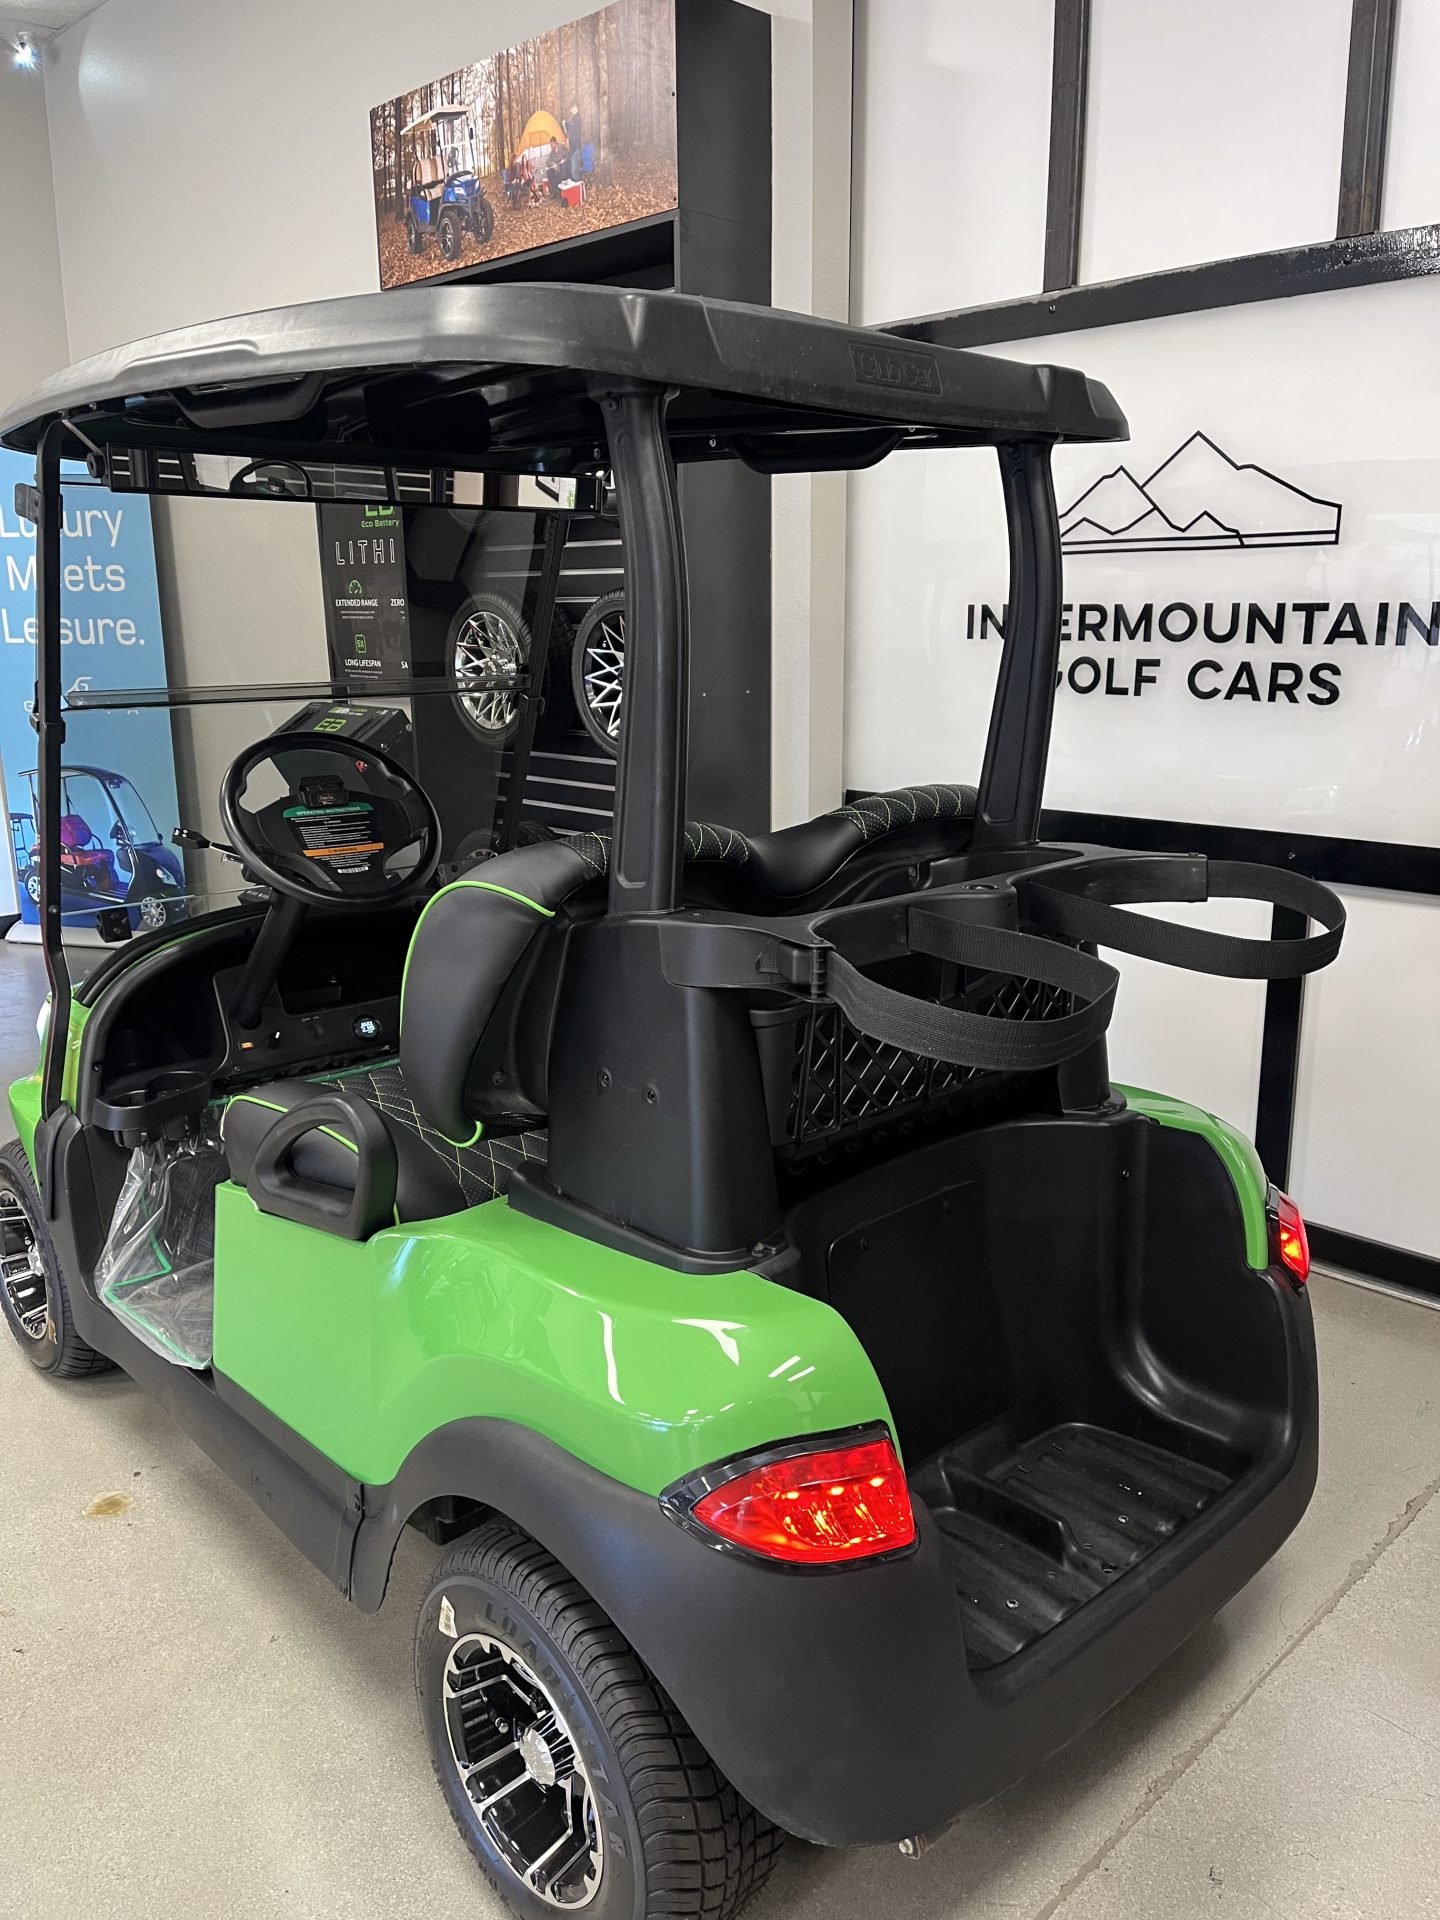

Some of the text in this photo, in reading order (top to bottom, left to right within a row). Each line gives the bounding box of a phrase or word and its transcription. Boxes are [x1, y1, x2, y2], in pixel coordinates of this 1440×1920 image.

[0, 503, 122, 547] Luury
[375, 519, 400, 527] Battery
[335, 538, 395, 565] LITHI
[6, 555, 125, 592] Mets
[335, 599, 379, 607] EXTENDED RANGE
[1, 608, 145, 646] Lesure.
[966, 601, 1440, 646] INERMOUNTAIN
[345, 659, 381, 668] LONG LIFESPAN
[1056, 656, 1342, 706] OLF CARS
